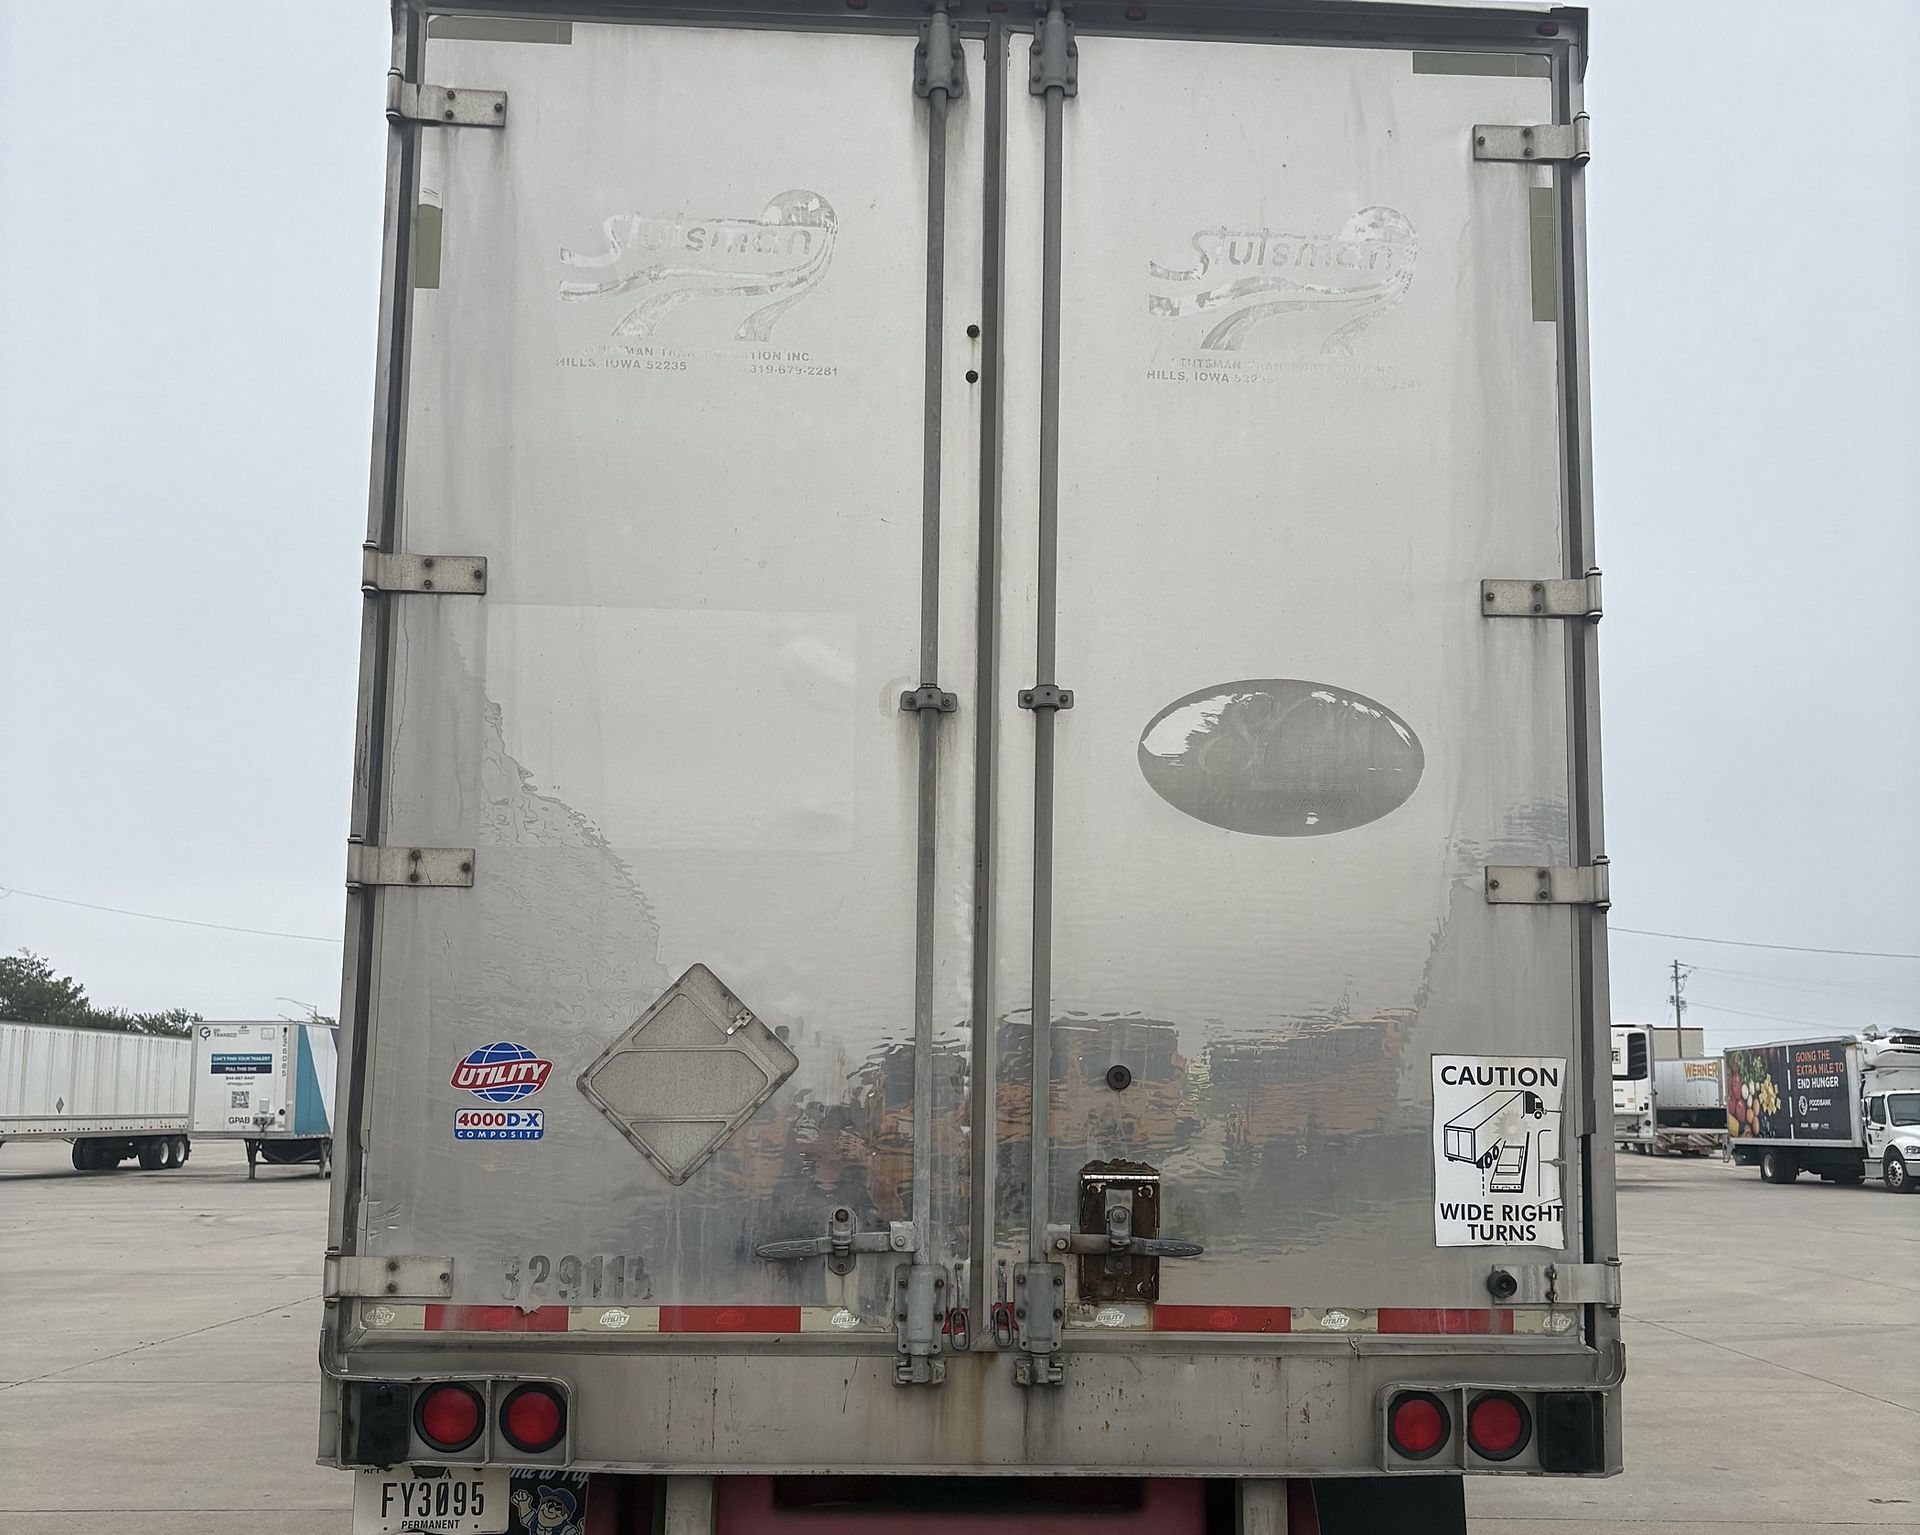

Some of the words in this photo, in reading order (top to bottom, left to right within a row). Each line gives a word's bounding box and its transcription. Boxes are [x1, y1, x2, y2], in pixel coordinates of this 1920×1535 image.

[605, 359, 641, 369] IOWA
[646, 360, 687, 370] 52235
[1171, 357, 1241, 370] TUTSMAN
[1194, 372, 1230, 383] IOWA
[1796, 1051, 1816, 1062] GOING
[1817, 1049, 1831, 1060] THE
[457, 1063, 547, 1086] UTILITY
[1440, 1065, 1558, 1087] CAUTION
[1684, 1062, 1720, 1080] WERNER
[1796, 1064, 1817, 1076] EXTRA
[1818, 1063, 1834, 1074] MILE
[1835, 1062, 1844, 1072] TO
[1797, 1078, 1811, 1089] END
[1811, 1076, 1839, 1088] HUNGER
[458, 1113, 541, 1127] 4000D-X
[457, 1131, 540, 1139] COMPOSITE
[1440, 1203, 1494, 1221] WIDE
[1503, 1204, 1563, 1222] RIGHT
[1467, 1224, 1537, 1241] TURNS
[381, 1481, 485, 1518] FY3095
[401, 1519, 461, 1530] PERMANENT
